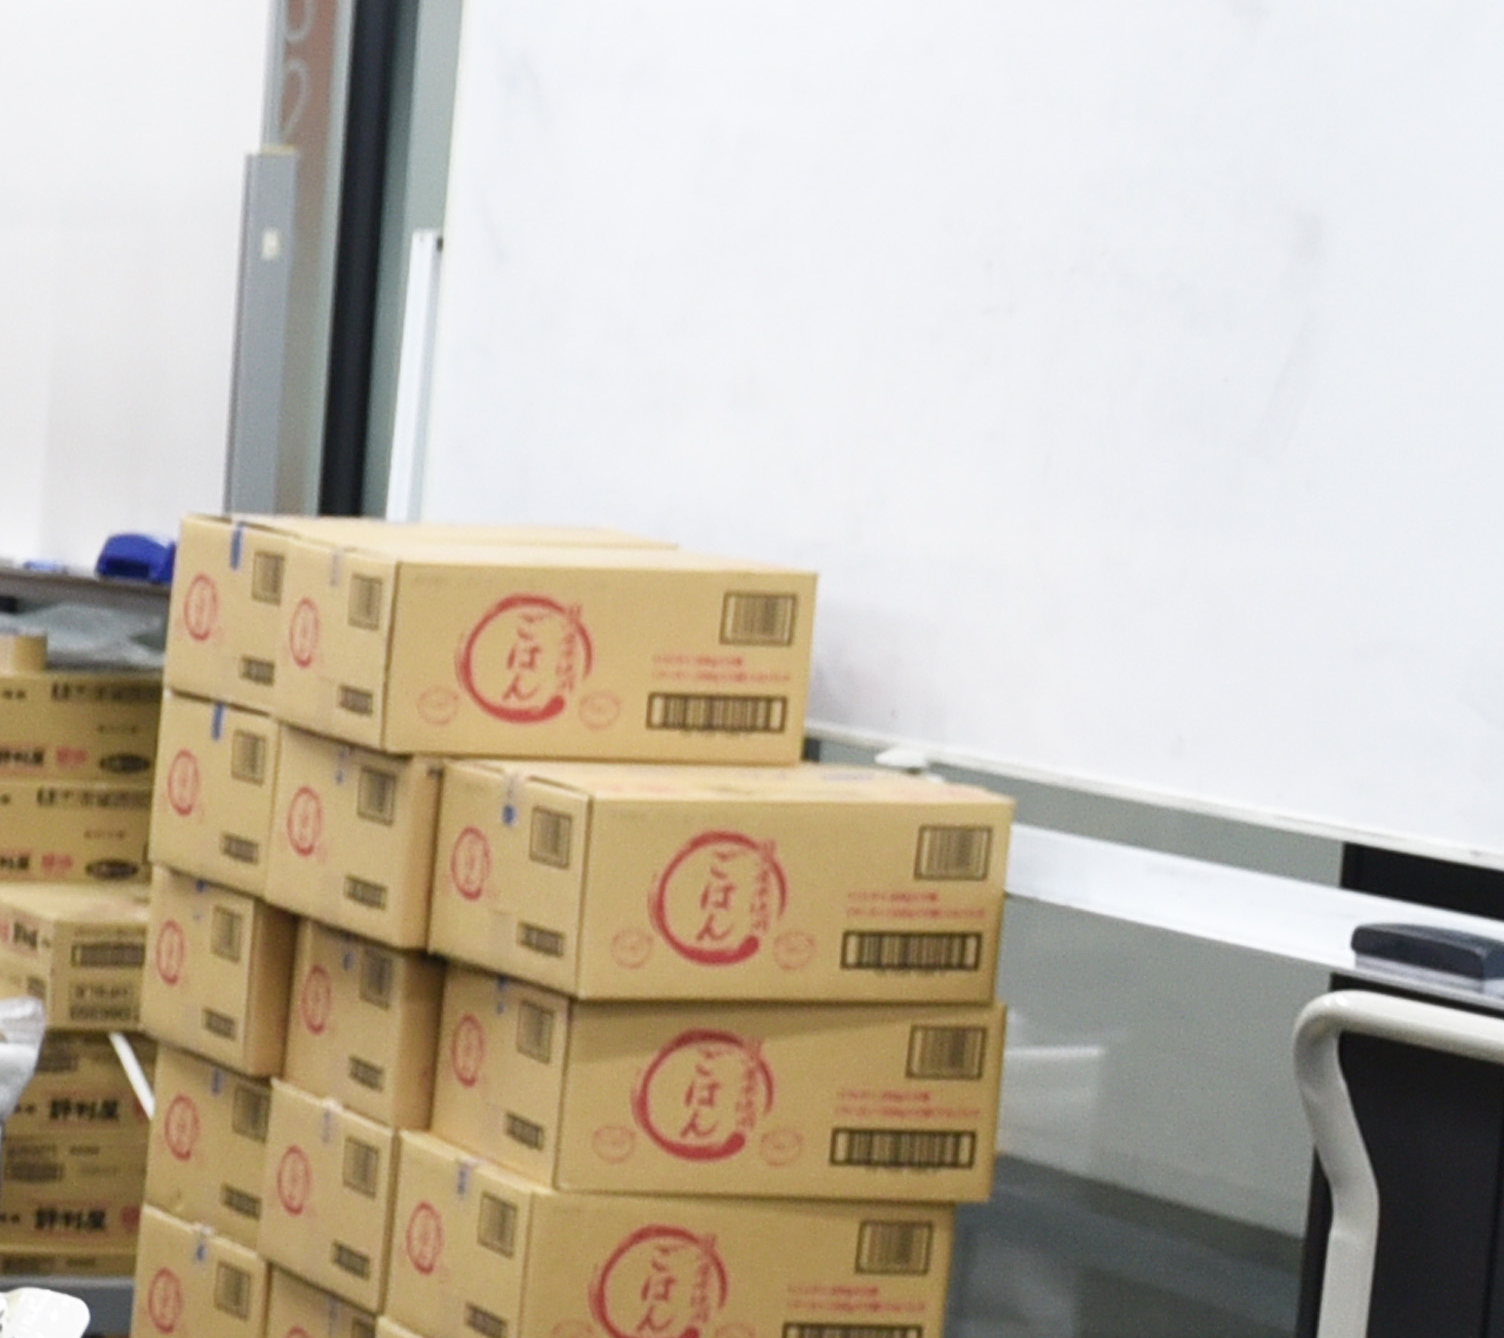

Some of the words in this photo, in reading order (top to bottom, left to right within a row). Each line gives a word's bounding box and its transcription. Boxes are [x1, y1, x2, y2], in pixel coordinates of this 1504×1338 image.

[501, 614, 545, 702] ごはん
[695, 851, 739, 945] ごはん
[678, 1050, 720, 1140] ごはん
[636, 1244, 678, 1336] ごはん
